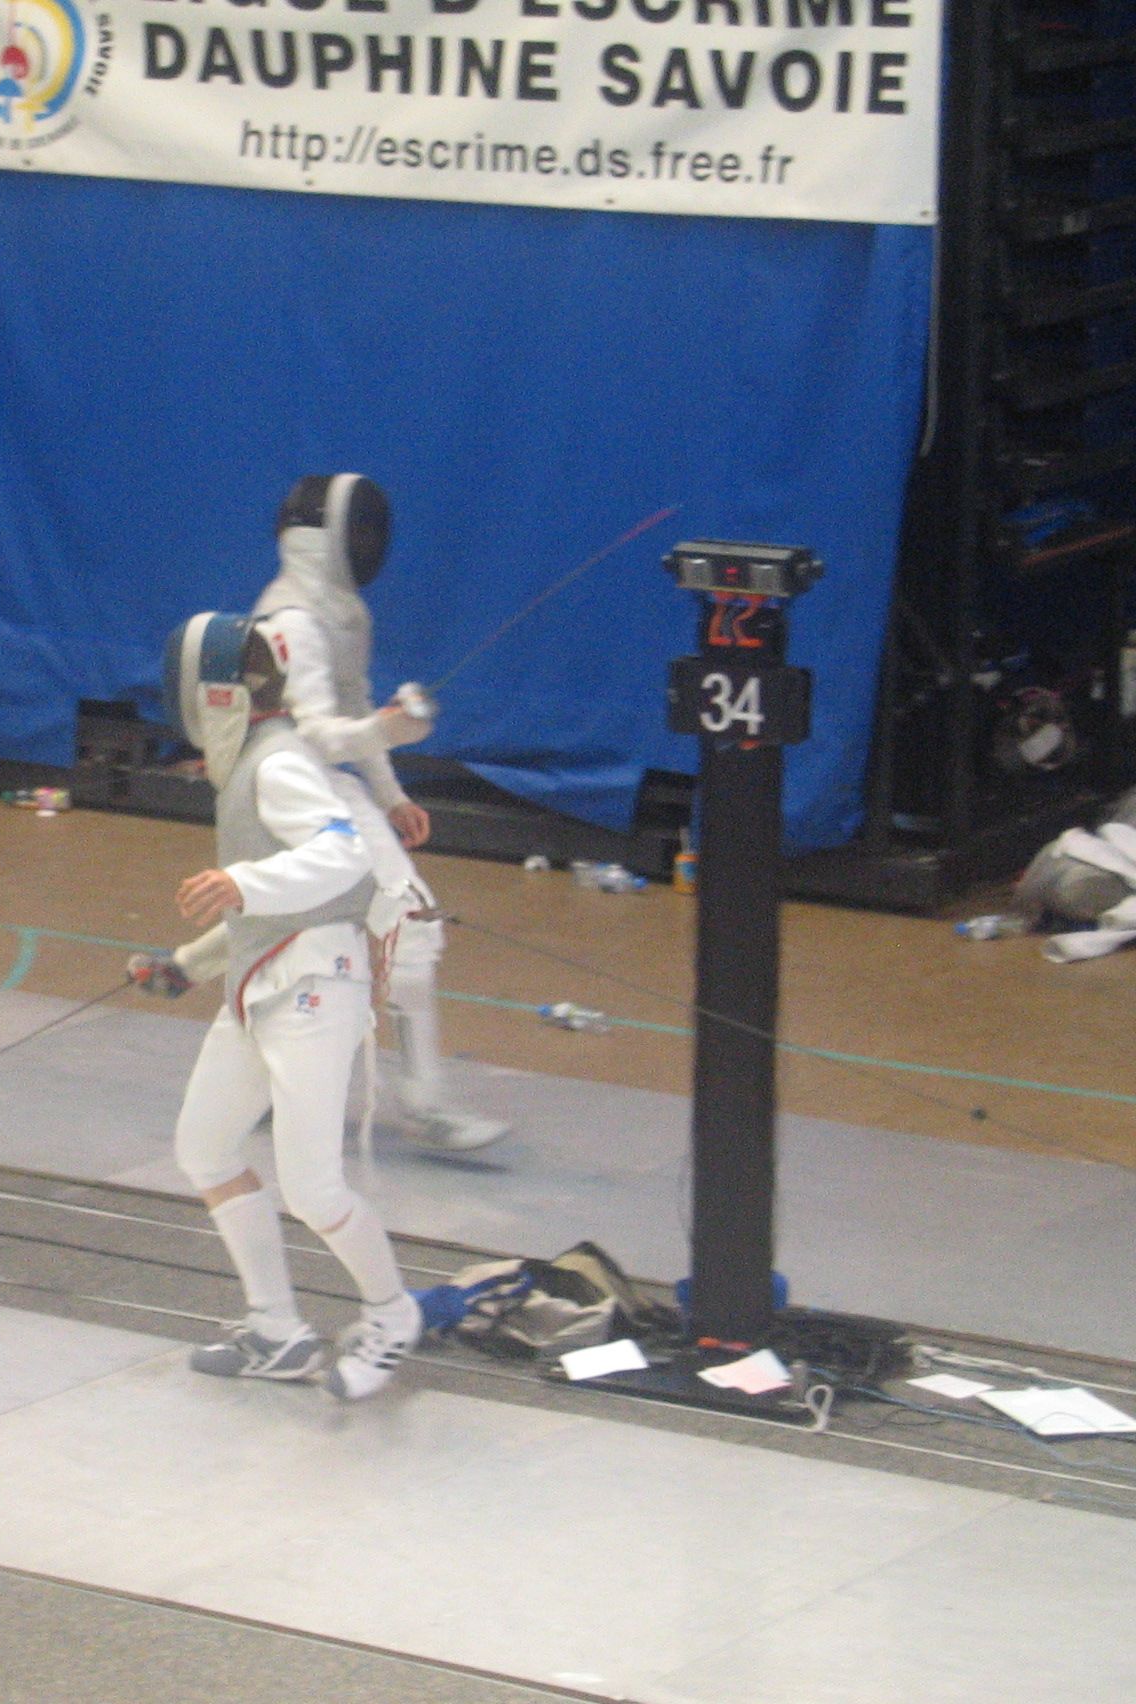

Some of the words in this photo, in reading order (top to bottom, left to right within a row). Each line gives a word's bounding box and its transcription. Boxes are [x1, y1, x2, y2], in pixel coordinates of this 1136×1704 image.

[143, 22, 559, 101] DAUPHINE
[599, 43, 909, 114] SAVOIE
[240, 119, 793, 185] http://escrime.ds.free.fr
[700, 672, 764, 736] 34
